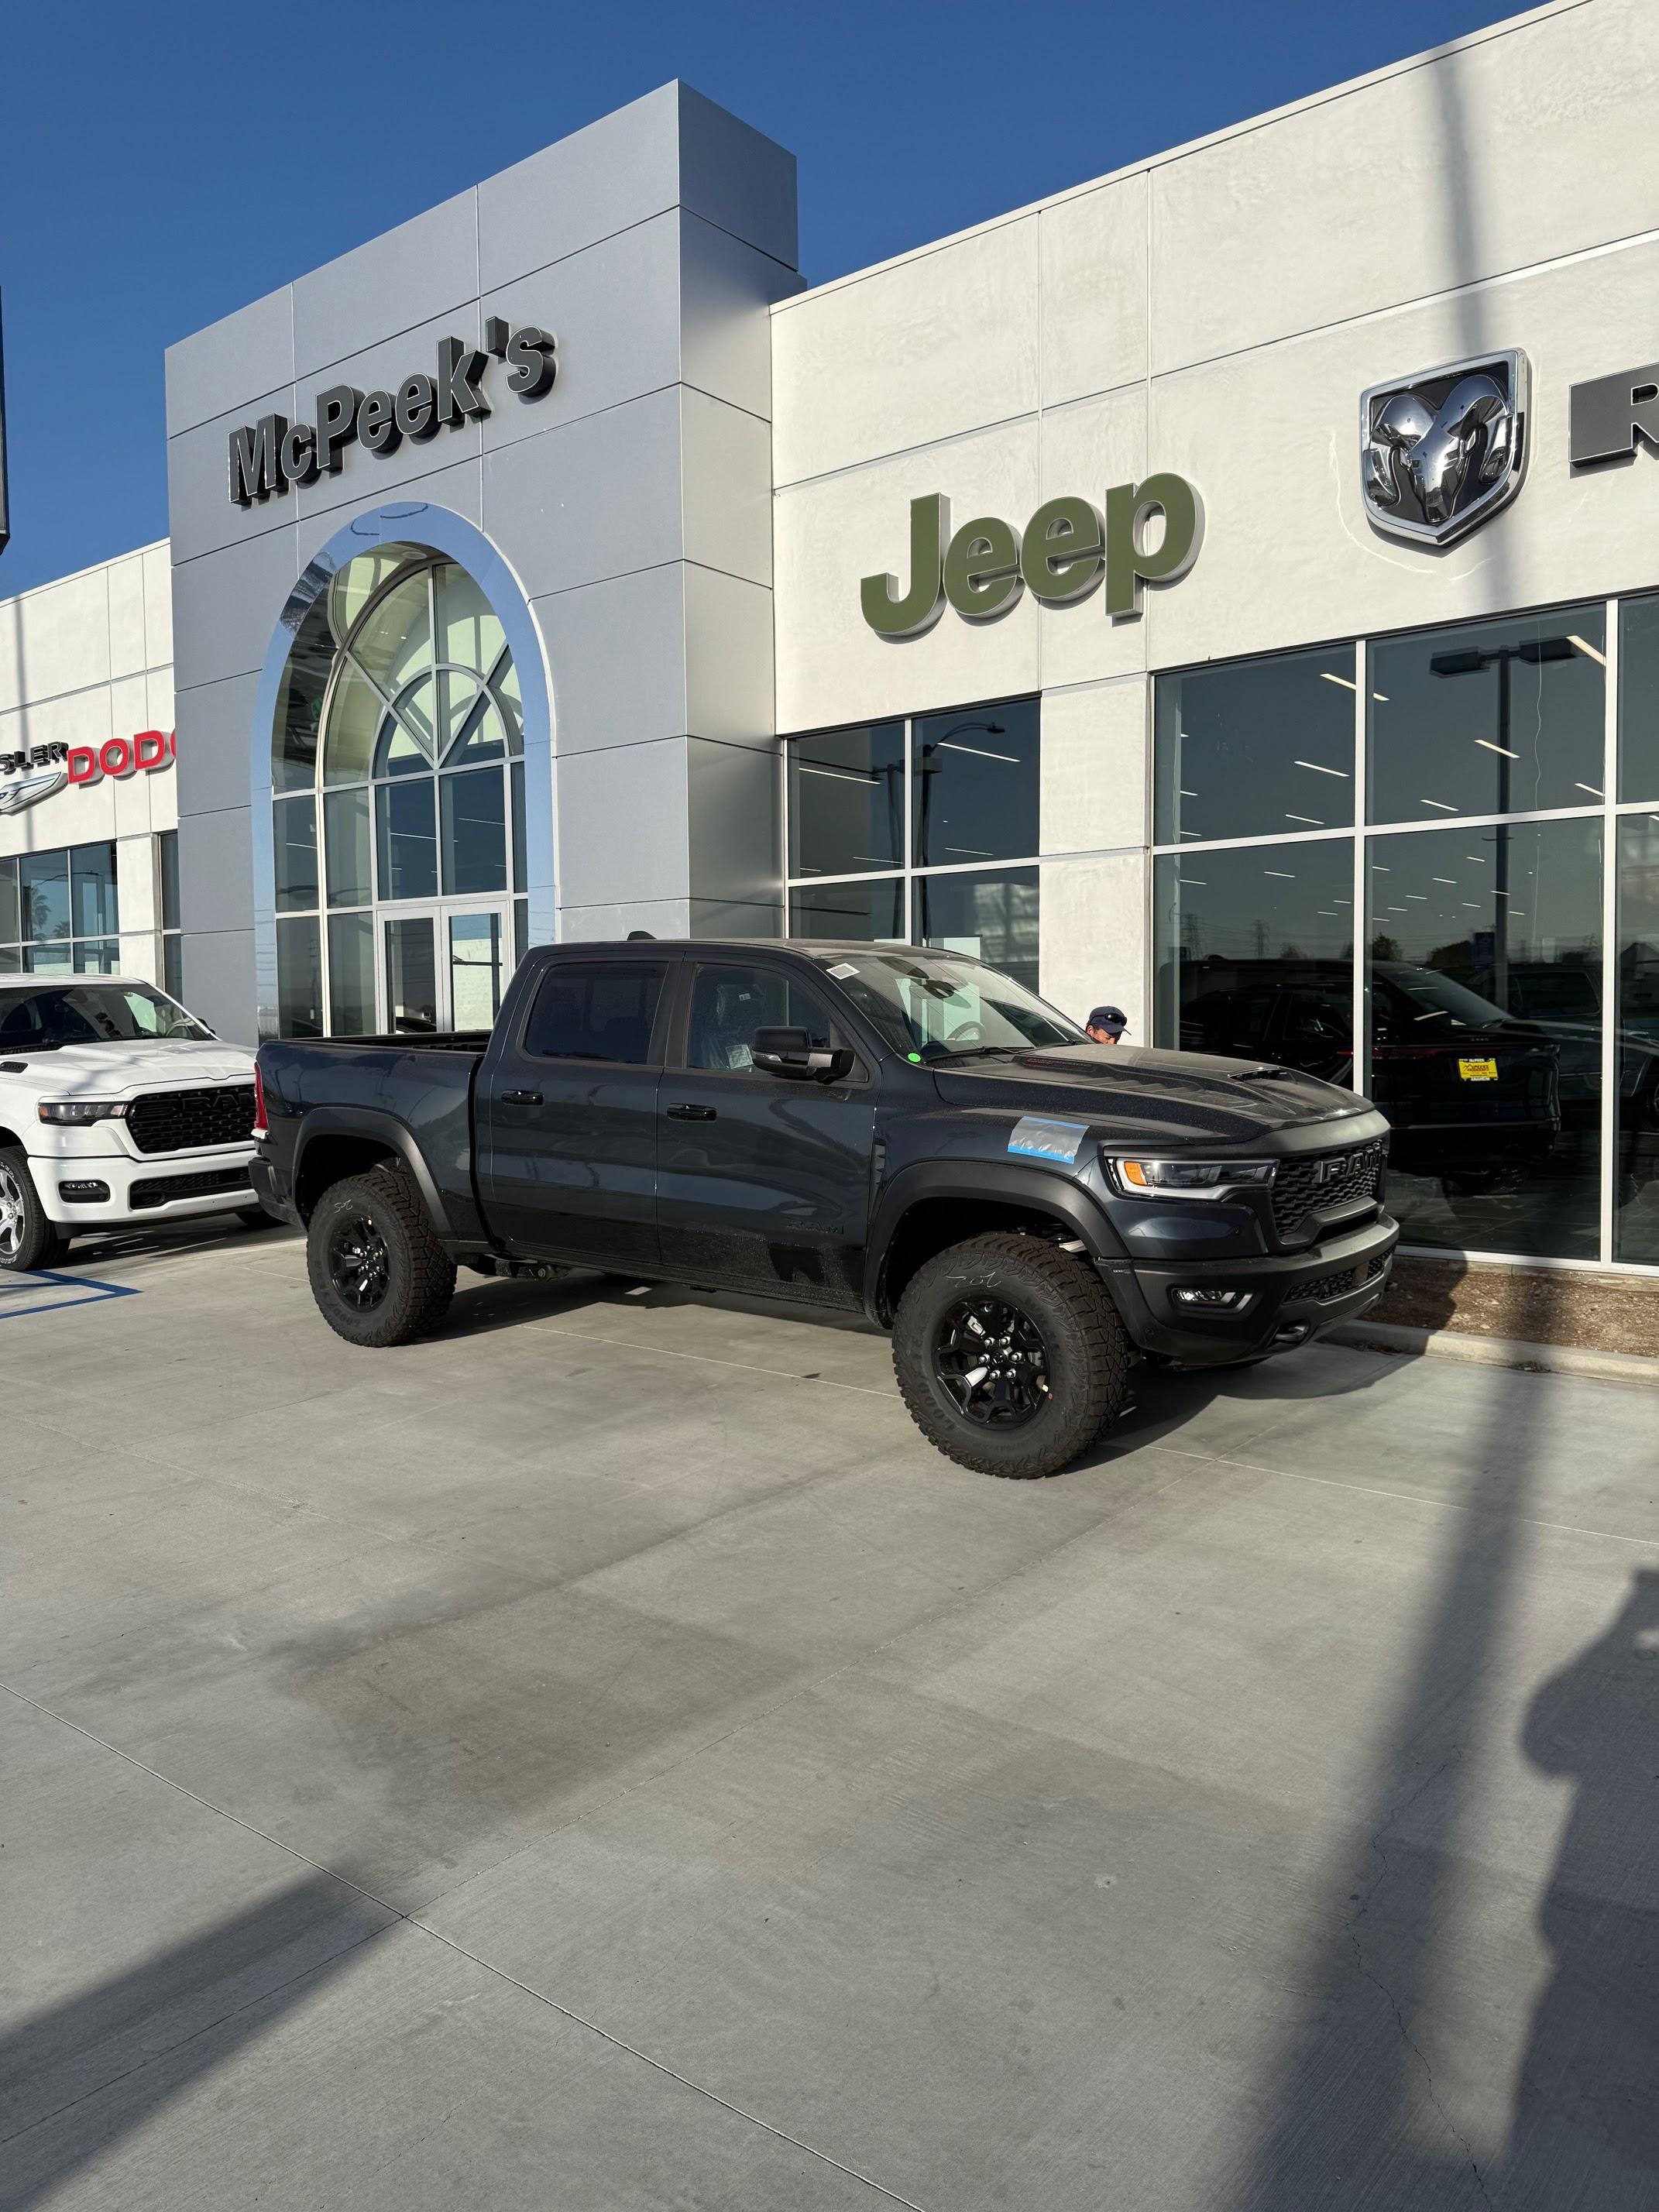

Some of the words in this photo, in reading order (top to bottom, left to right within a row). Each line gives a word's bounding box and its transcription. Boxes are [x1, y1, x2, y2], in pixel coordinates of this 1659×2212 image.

[228, 315, 556, 507] McPeek's
[860, 472, 1203, 635] Jeep
[67, 730, 176, 785] DOD
